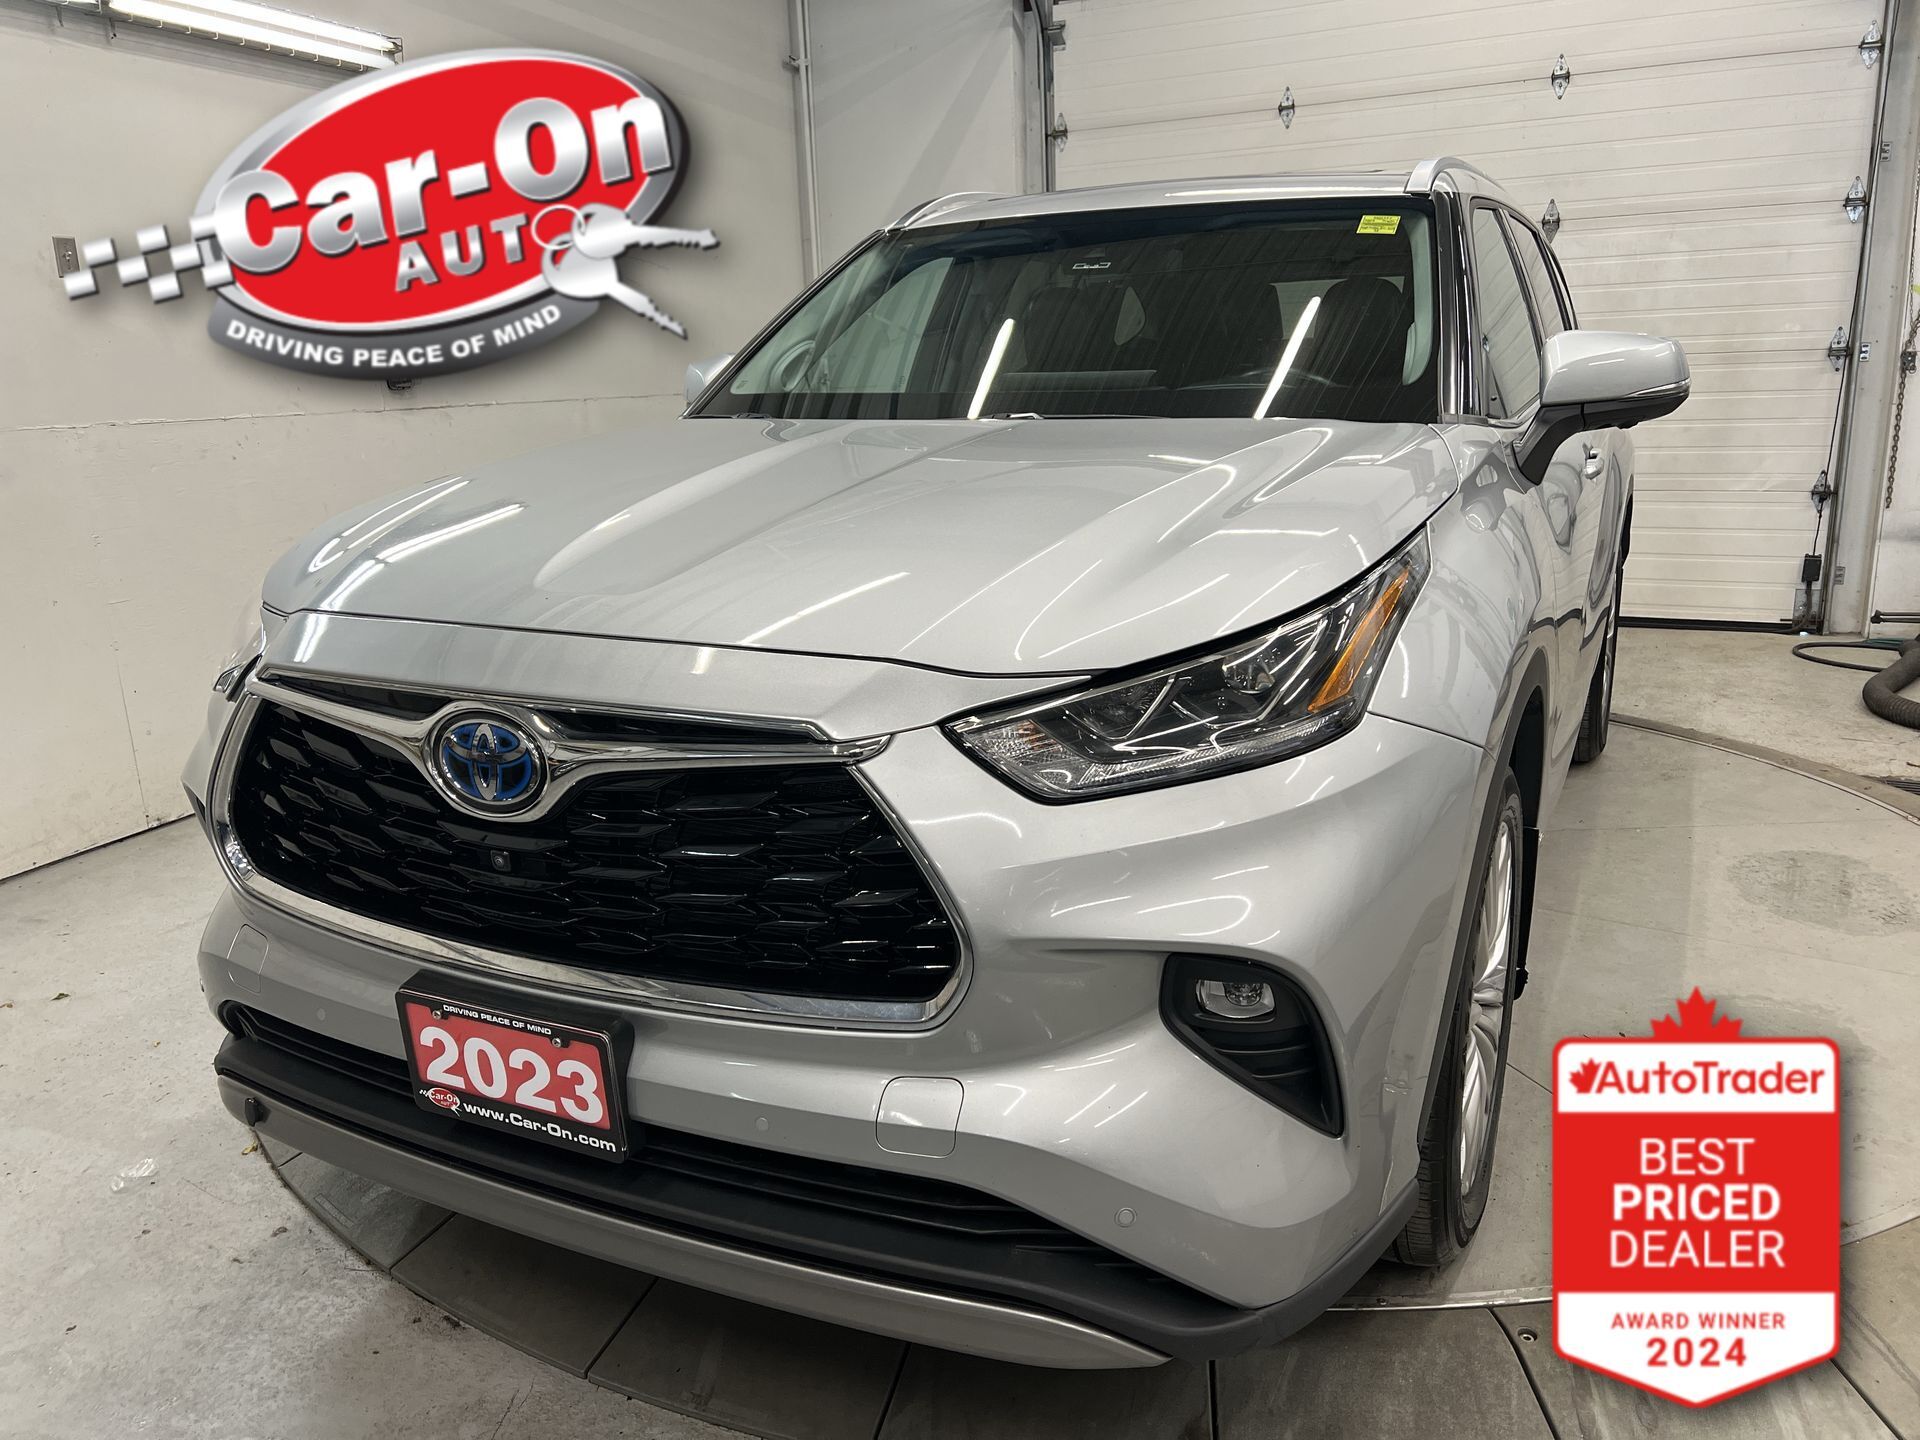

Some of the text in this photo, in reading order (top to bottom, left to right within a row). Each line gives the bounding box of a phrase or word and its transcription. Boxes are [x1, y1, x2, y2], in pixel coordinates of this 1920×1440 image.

[443, 1004, 552, 1035] DRIVING PEACE OF MIND
[419, 1026, 604, 1124] 2023
[463, 1102, 616, 1153] www.Car-On.com
